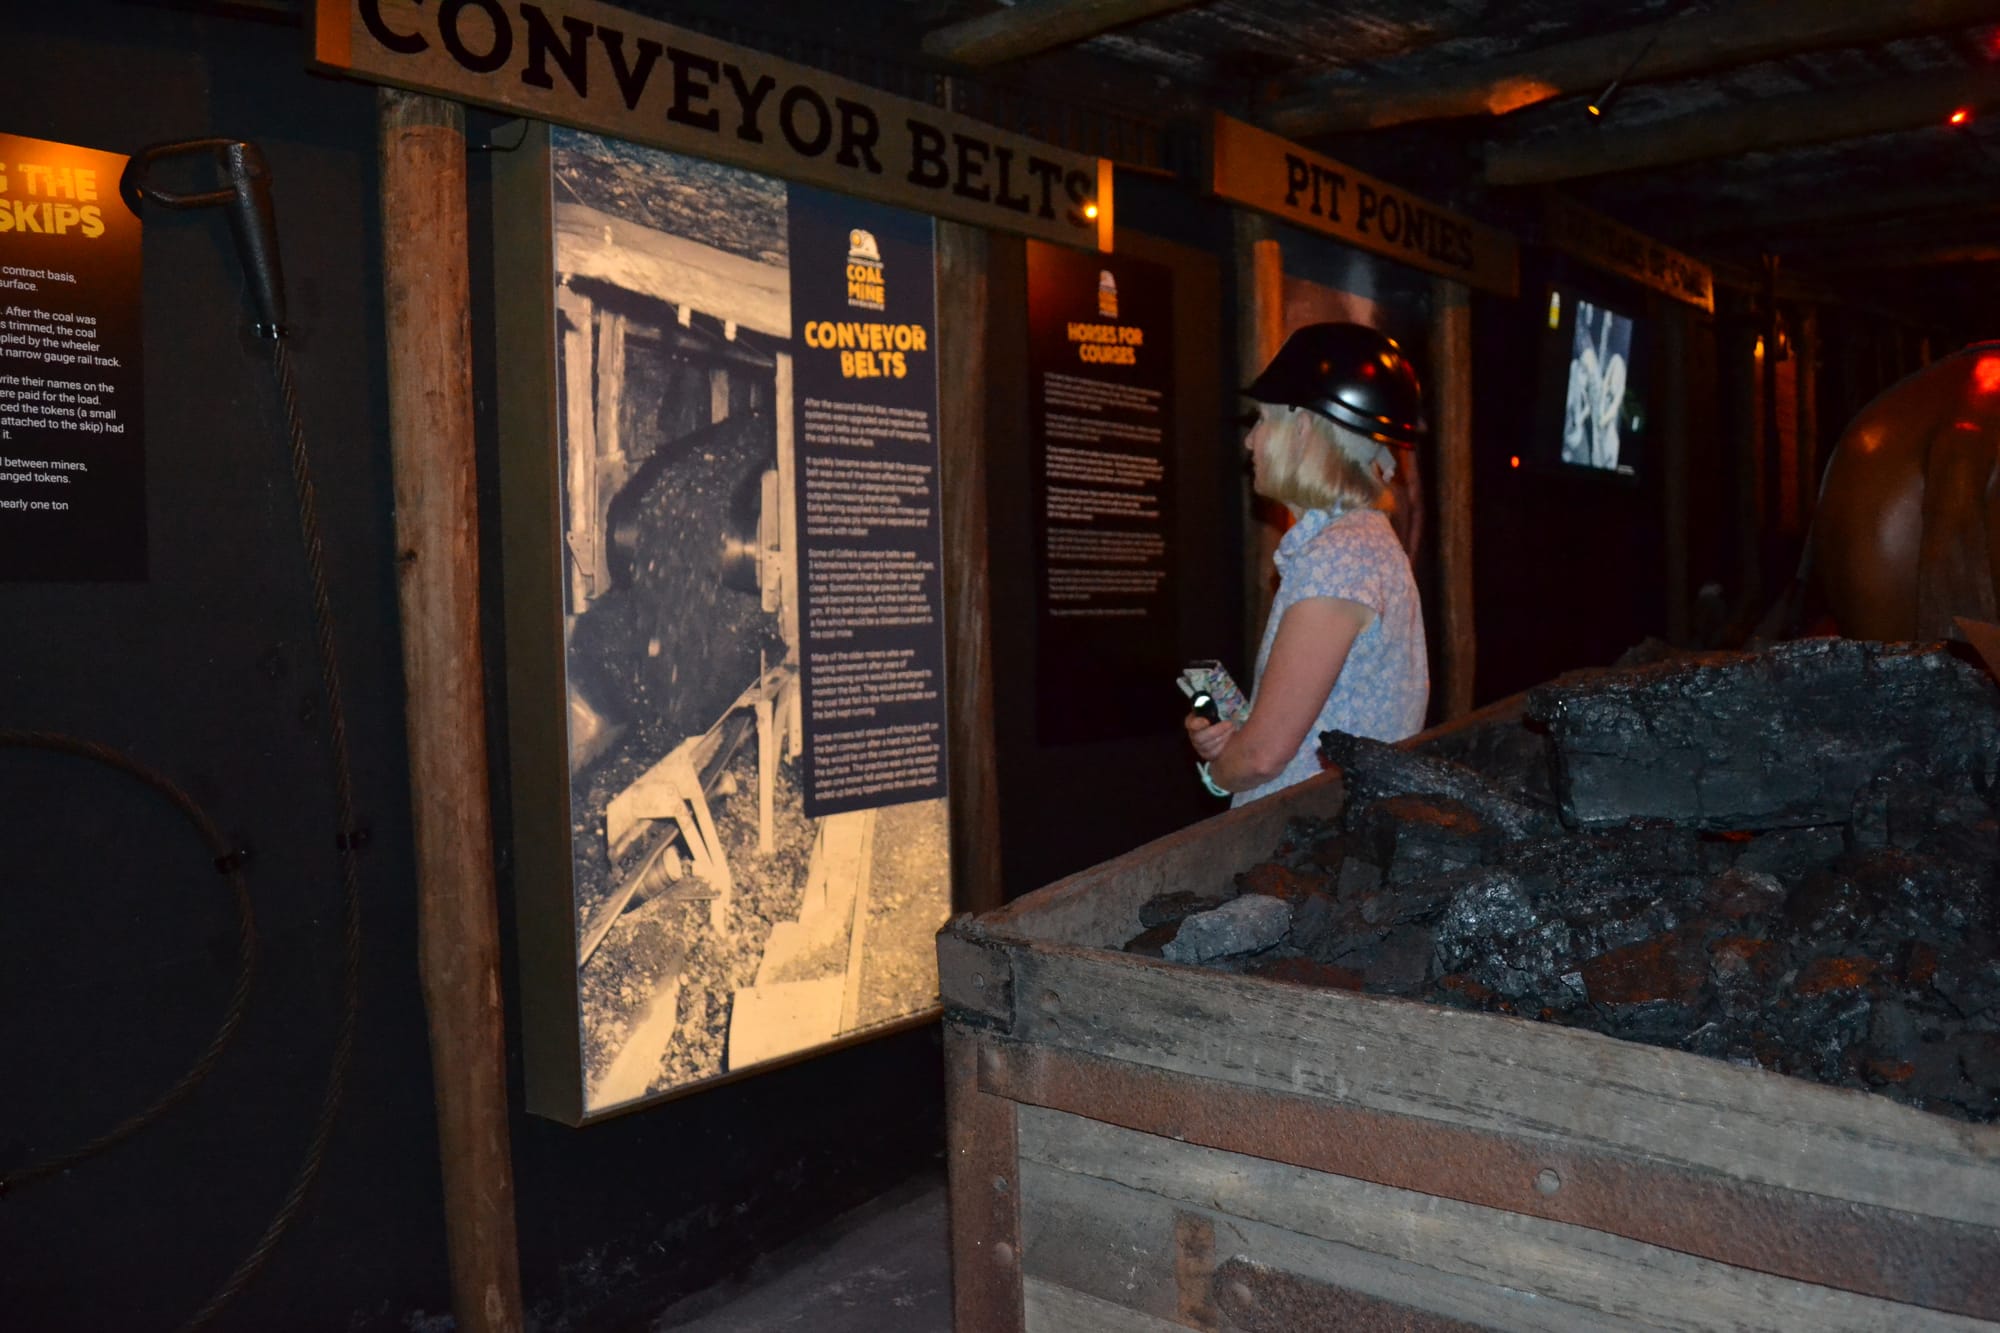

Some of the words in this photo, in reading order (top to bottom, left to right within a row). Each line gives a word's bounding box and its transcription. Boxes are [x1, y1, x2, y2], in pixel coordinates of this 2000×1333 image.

[360, 0, 882, 174] CONVEYOR
[905, 118, 1094, 228] BELTS
[18, 163, 98, 202] THE
[1285, 152, 1346, 221] PIT
[1356, 183, 1474, 270] PONIES
[2, 266, 45, 278] contract
[47, 270, 76, 284] basis,
[846, 262, 885, 284] COAL
[847, 281, 886, 305] MINE
[6, 306, 31, 317] After
[34, 310, 50, 319] the
[52, 313, 73, 322] coal
[76, 316, 96, 325] was
[9, 321, 55, 335] trimmed,
[57, 325, 73, 335] the
[75, 328, 96, 338] coal
[804, 320, 927, 352] CONVEYOR
[29, 336, 40, 348] by
[43, 338, 59, 347] the
[61, 341, 100, 352] wheeler
[6, 349, 41, 359] narrow
[44, 353, 75, 364] gauge
[78, 355, 92, 364] rail
[95, 357, 121, 367] track.
[840, 350, 908, 380] BELTS
[22, 376, 45, 386] their
[47, 380, 82, 390] names
[83, 383, 96, 391] on
[98, 383, 115, 393] the
[18, 391, 40, 400] paid
[42, 391, 57, 401] for
[59, 393, 75, 403] the
[77, 394, 101, 405] load.
[22, 403, 38, 414] the
[41, 406, 75, 416] tokens
[77, 407, 87, 418] (a
[89, 410, 116, 419] small
[1, 417, 46, 428] attached
[48, 419, 59, 429] to
[61, 420, 77, 430] the
[80, 421, 103, 433] skip)
[105, 423, 124, 433] had
[3, 430, 12, 439] it.
[5, 457, 49, 469] between
[51, 460, 87, 472] miners,
[34, 473, 71, 483] tokens.
[30, 501, 50, 510] one
[52, 501, 69, 510] ton
